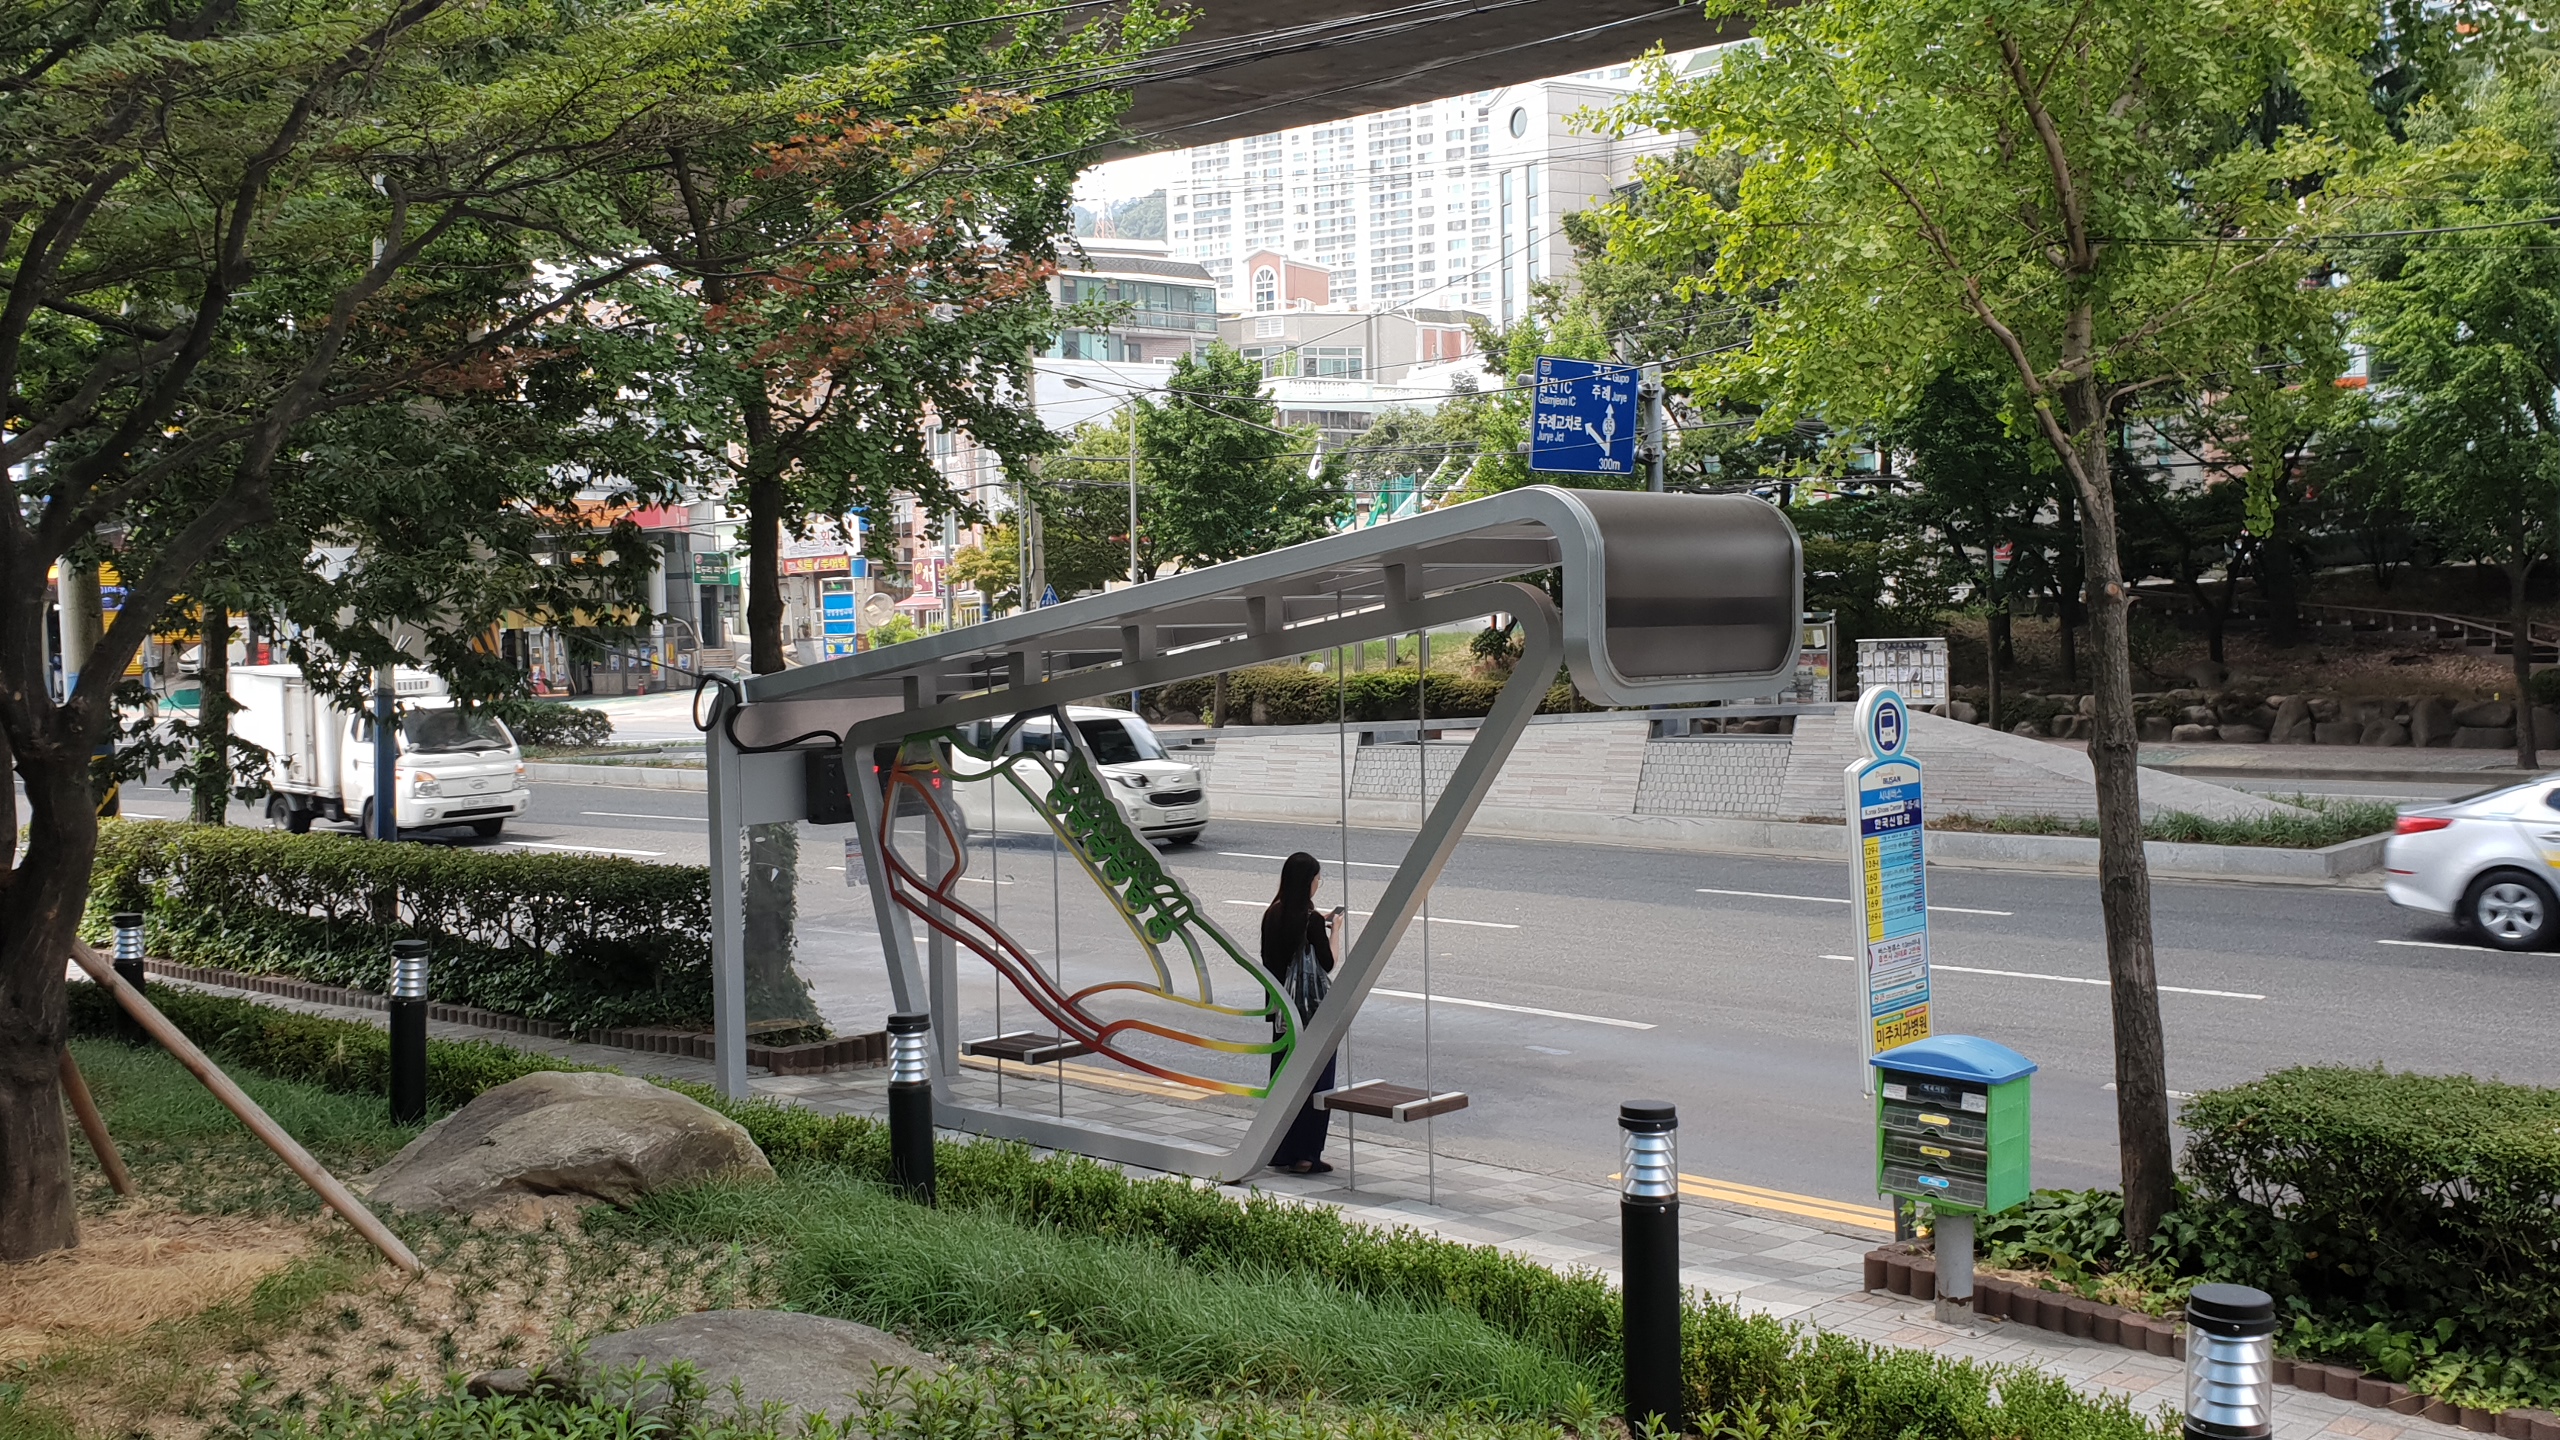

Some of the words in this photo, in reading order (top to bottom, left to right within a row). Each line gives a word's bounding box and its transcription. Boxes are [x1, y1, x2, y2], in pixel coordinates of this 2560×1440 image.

[1612, 373, 1630, 385] Gupo
[1560, 381, 1573, 394] IC
[1591, 384, 1611, 402] 주례
[1611, 391, 1627, 405] Jurye
[1538, 393, 1568, 408] Gamjeon
[1569, 395, 1576, 406] IC
[1537, 413, 1583, 432] 주례교차로
[1537, 430, 1554, 444] Jurye
[1555, 431, 1565, 443] Jct
[1598, 457, 1621, 471] 300m
[1883, 776, 1901, 784] BUSAN
[1879, 788, 1903, 801] 시내버스
[1874, 813, 1910, 830] 한국신발관
[1866, 873, 1878, 882] 160
[1868, 899, 1879, 908] 169
[1876, 1014, 1927, 1047] 미주치과병원
